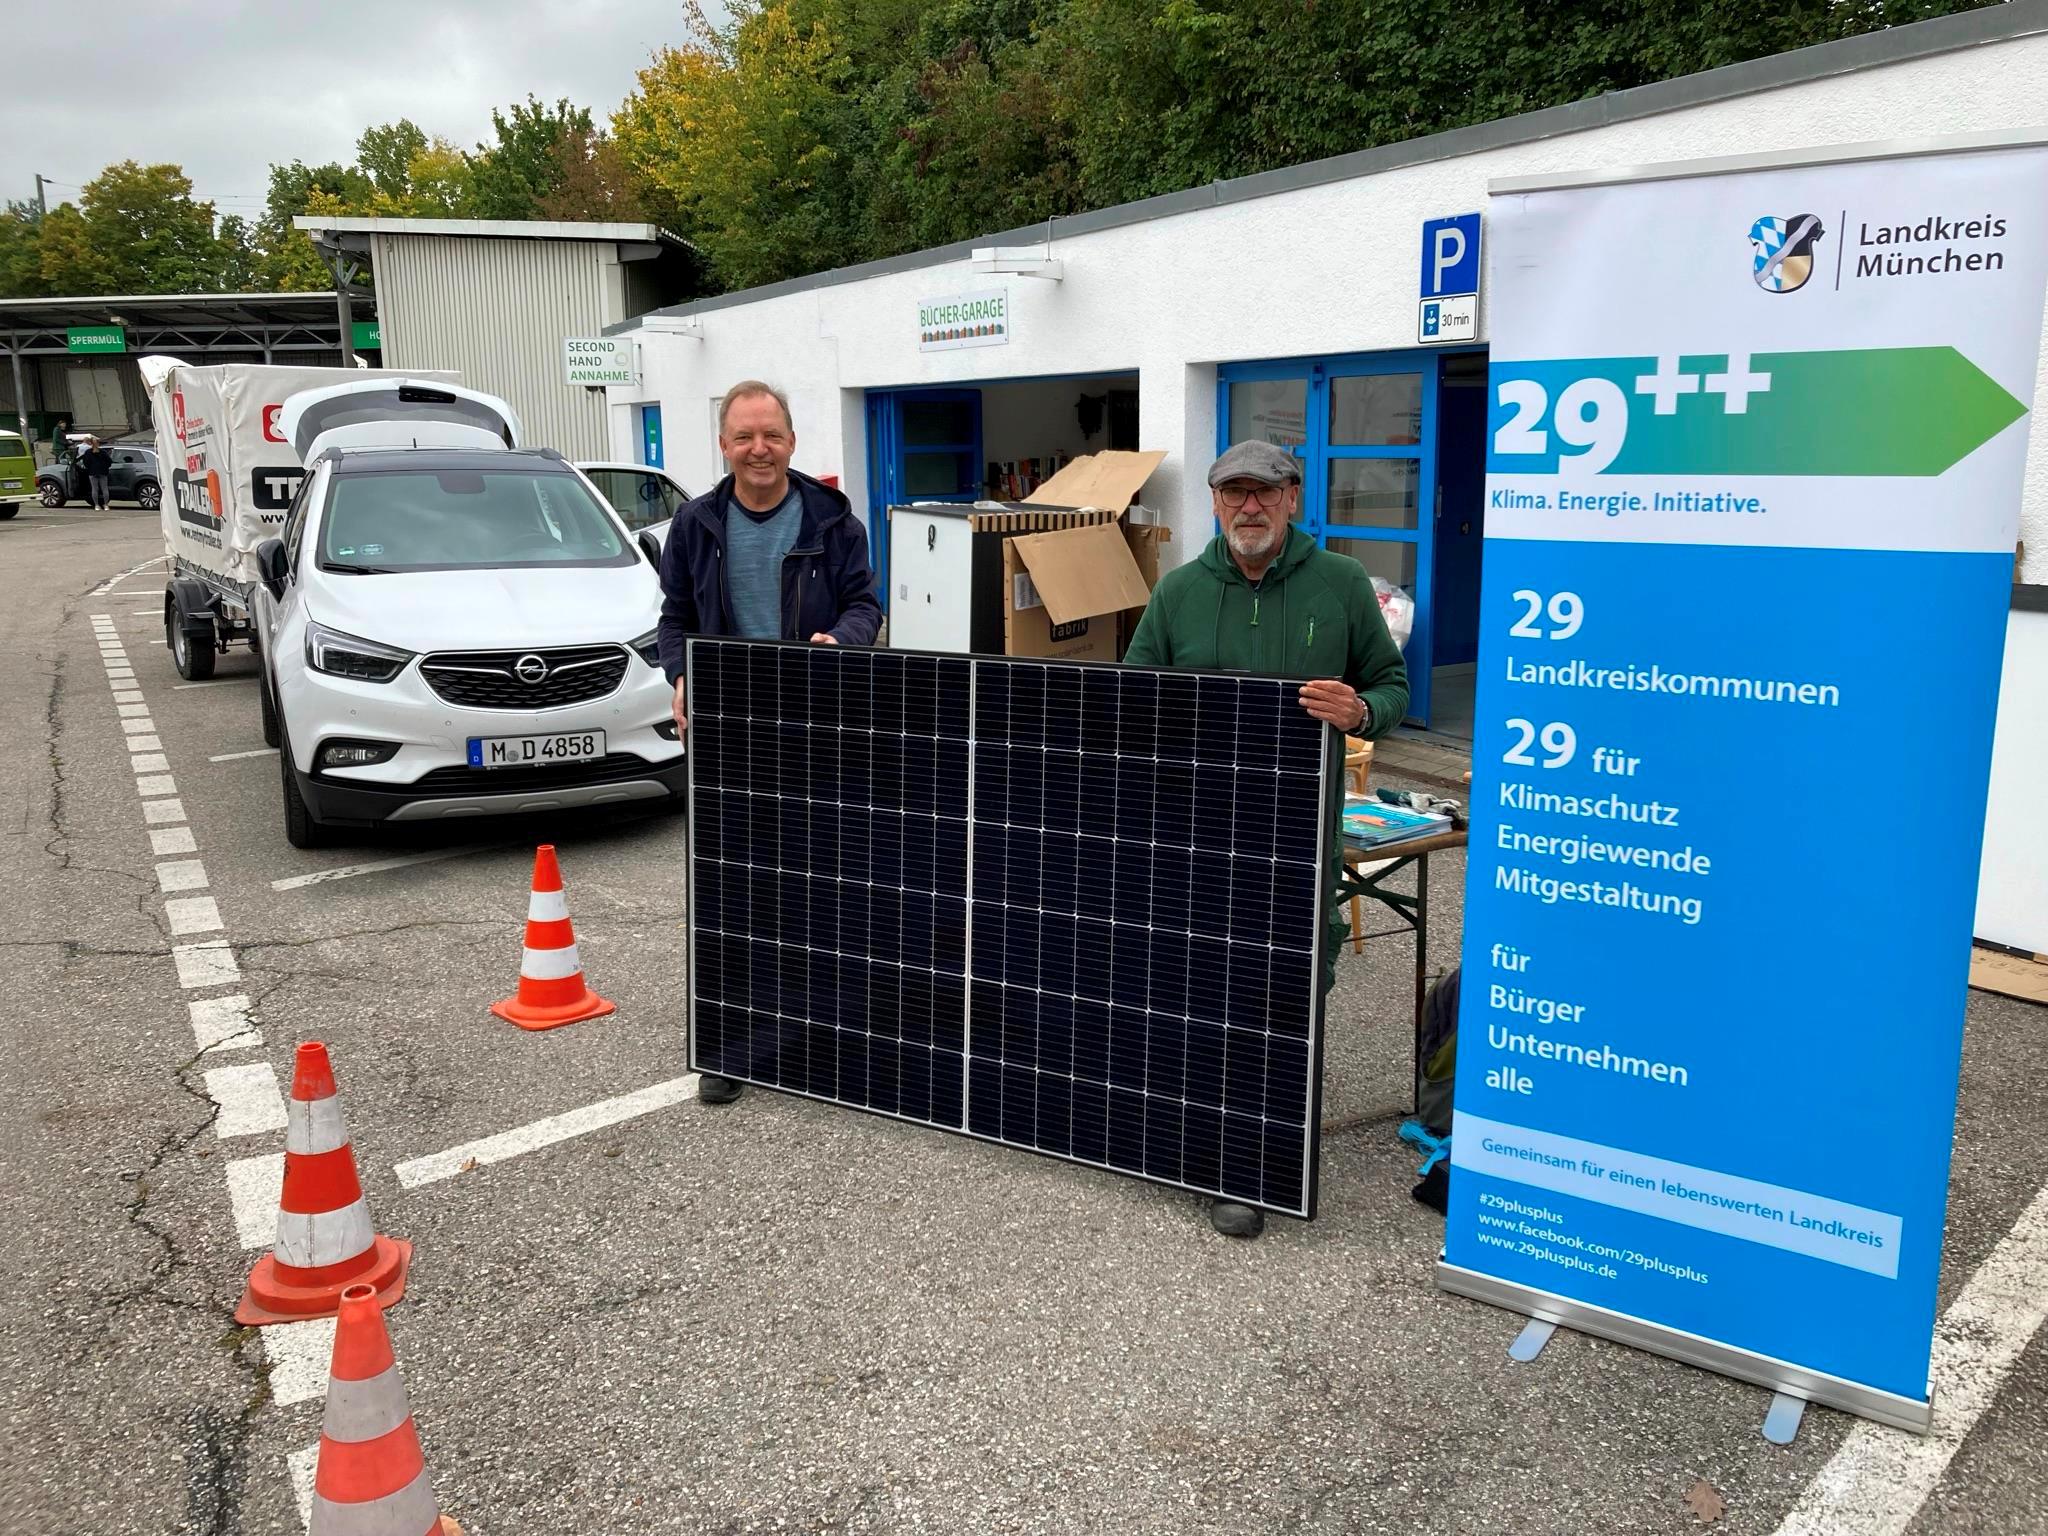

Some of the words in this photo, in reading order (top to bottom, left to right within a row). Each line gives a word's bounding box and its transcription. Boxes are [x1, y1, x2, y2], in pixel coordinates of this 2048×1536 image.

[1859, 213, 2007, 246] Landkreis
[1433, 227, 1466, 293] P
[1855, 248, 2004, 278] München
[920, 297, 1004, 327] BÜCHER-GARAGE
[1441, 314, 1452, 327] 30
[1453, 312, 1470, 326] min
[70, 333, 123, 345] SPERRMÜLL
[568, 341, 615, 352] SECOND
[569, 356, 602, 366] HAND
[570, 370, 629, 381] ANNAHME
[1491, 489, 1552, 510] Klima.
[1558, 490, 1647, 517] Energie.
[1653, 492, 1767, 514] Initiative.
[1508, 589, 1585, 640] 29
[1505, 656, 1840, 707] Landkreiskommunen
[473, 755, 479, 763] D
[491, 741, 506, 763] M
[522, 739, 536, 760] D
[541, 735, 595, 758] 4858
[1502, 717, 1577, 769] 29
[1592, 746, 1641, 777] für
[1499, 782, 1679, 827] Klimaschutz
[1497, 823, 1711, 875] Energiewende
[1495, 865, 1702, 925] Mitgestaltung
[1491, 943, 1531, 973] für
[1489, 984, 1586, 1024] Bürger
[1488, 1023, 1688, 1087] Unternehmen
[1485, 1065, 1534, 1095] alle
[1479, 1192, 1564, 1225] #29plusplus
[1481, 1137, 1577, 1172] Gemeinsam
[1581, 1160, 1605, 1178] für
[1609, 1169, 1656, 1191] einen
[1661, 1179, 1784, 1222] lebenswerten
[1789, 1210, 1884, 1249] Landkreis
[1477, 1231, 1618, 1280] www.29plusplus.de
[1478, 1213, 1709, 1285] www.facebook.com/29plusplus
